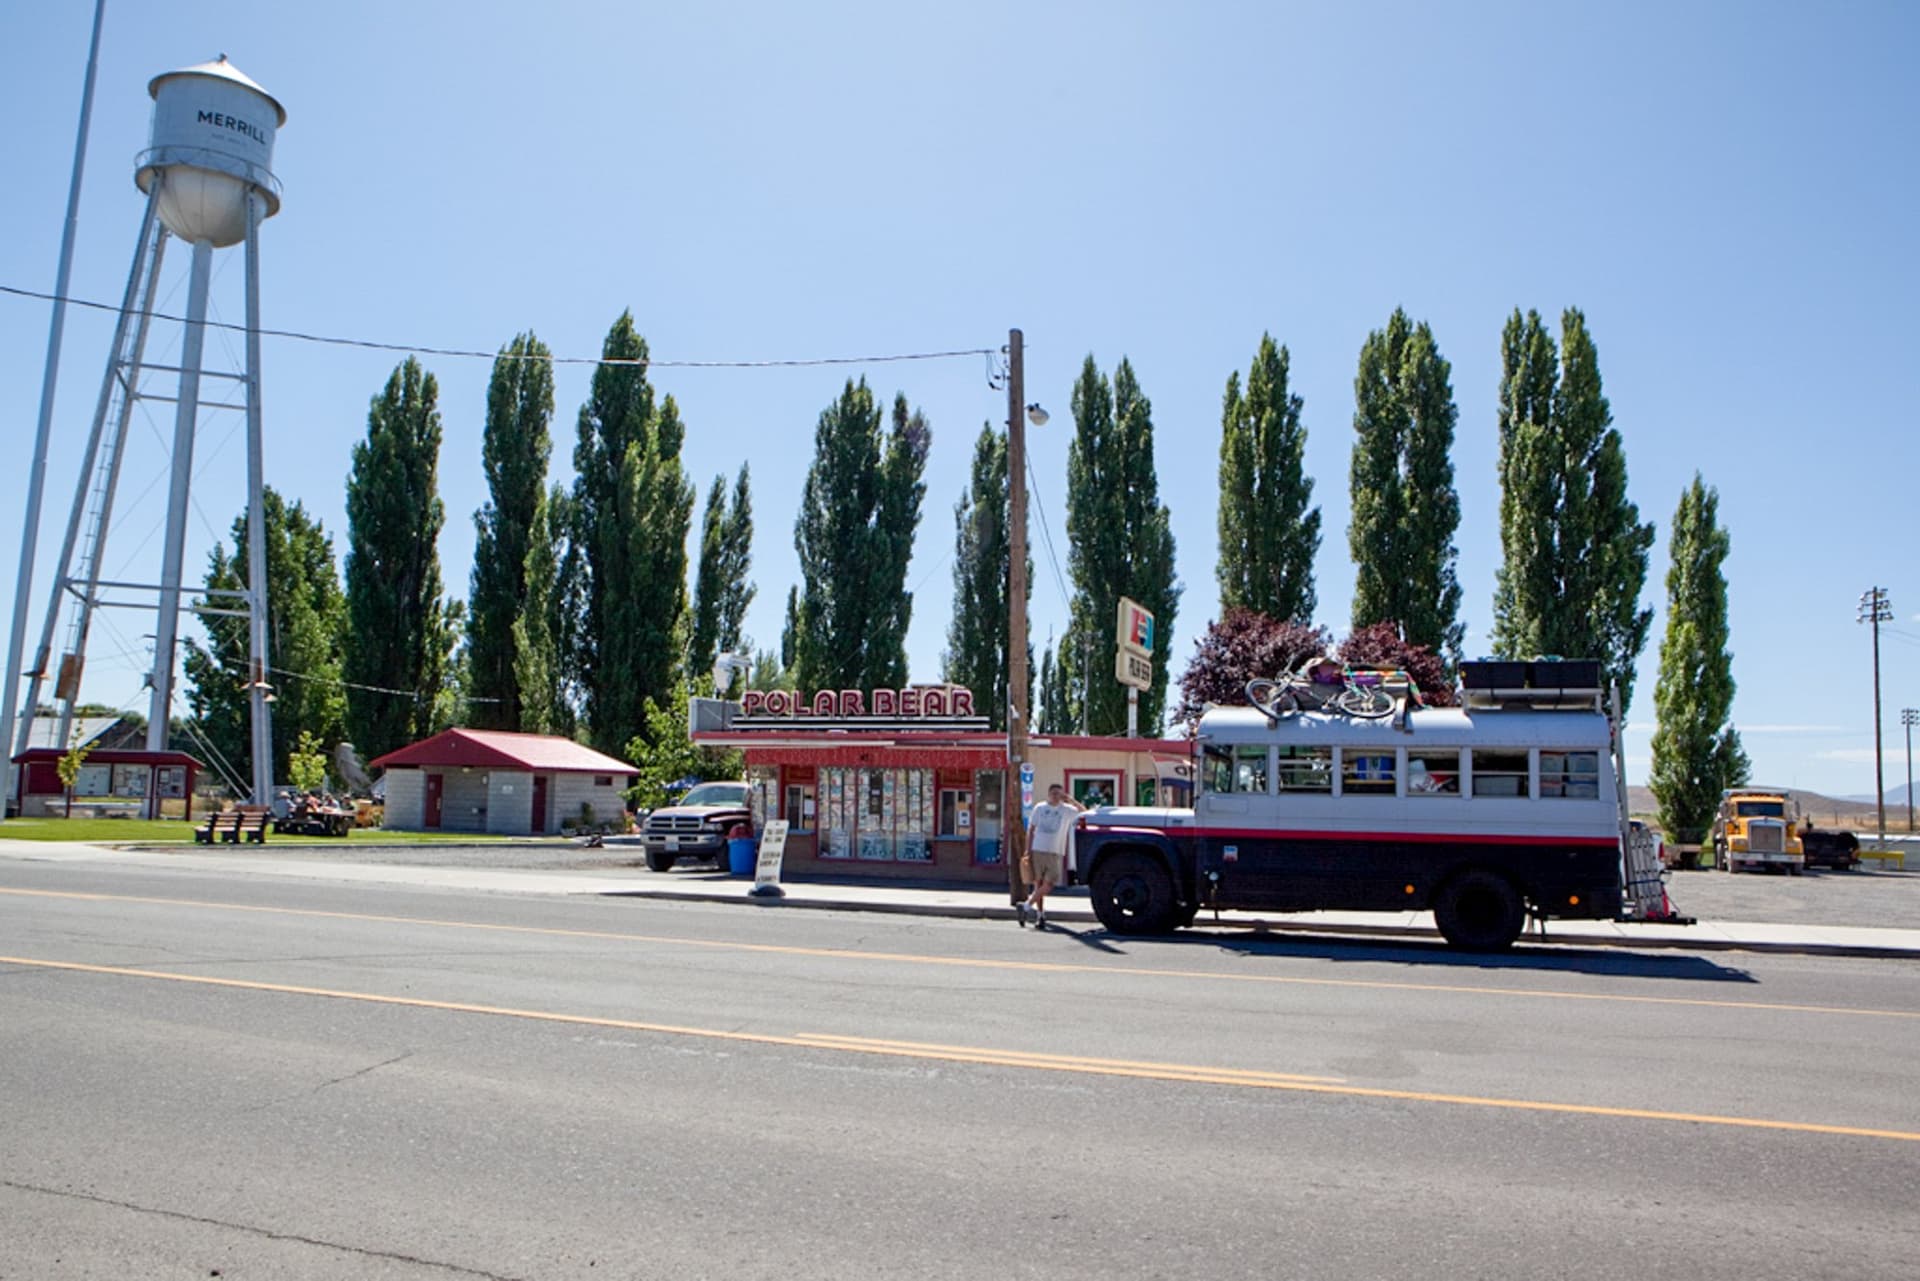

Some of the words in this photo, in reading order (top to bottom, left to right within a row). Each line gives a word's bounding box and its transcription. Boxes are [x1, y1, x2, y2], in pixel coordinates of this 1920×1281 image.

[197, 109, 266, 145] MERRILL
[742, 689, 865, 716] POLAR
[872, 688, 974, 716] BEAR
